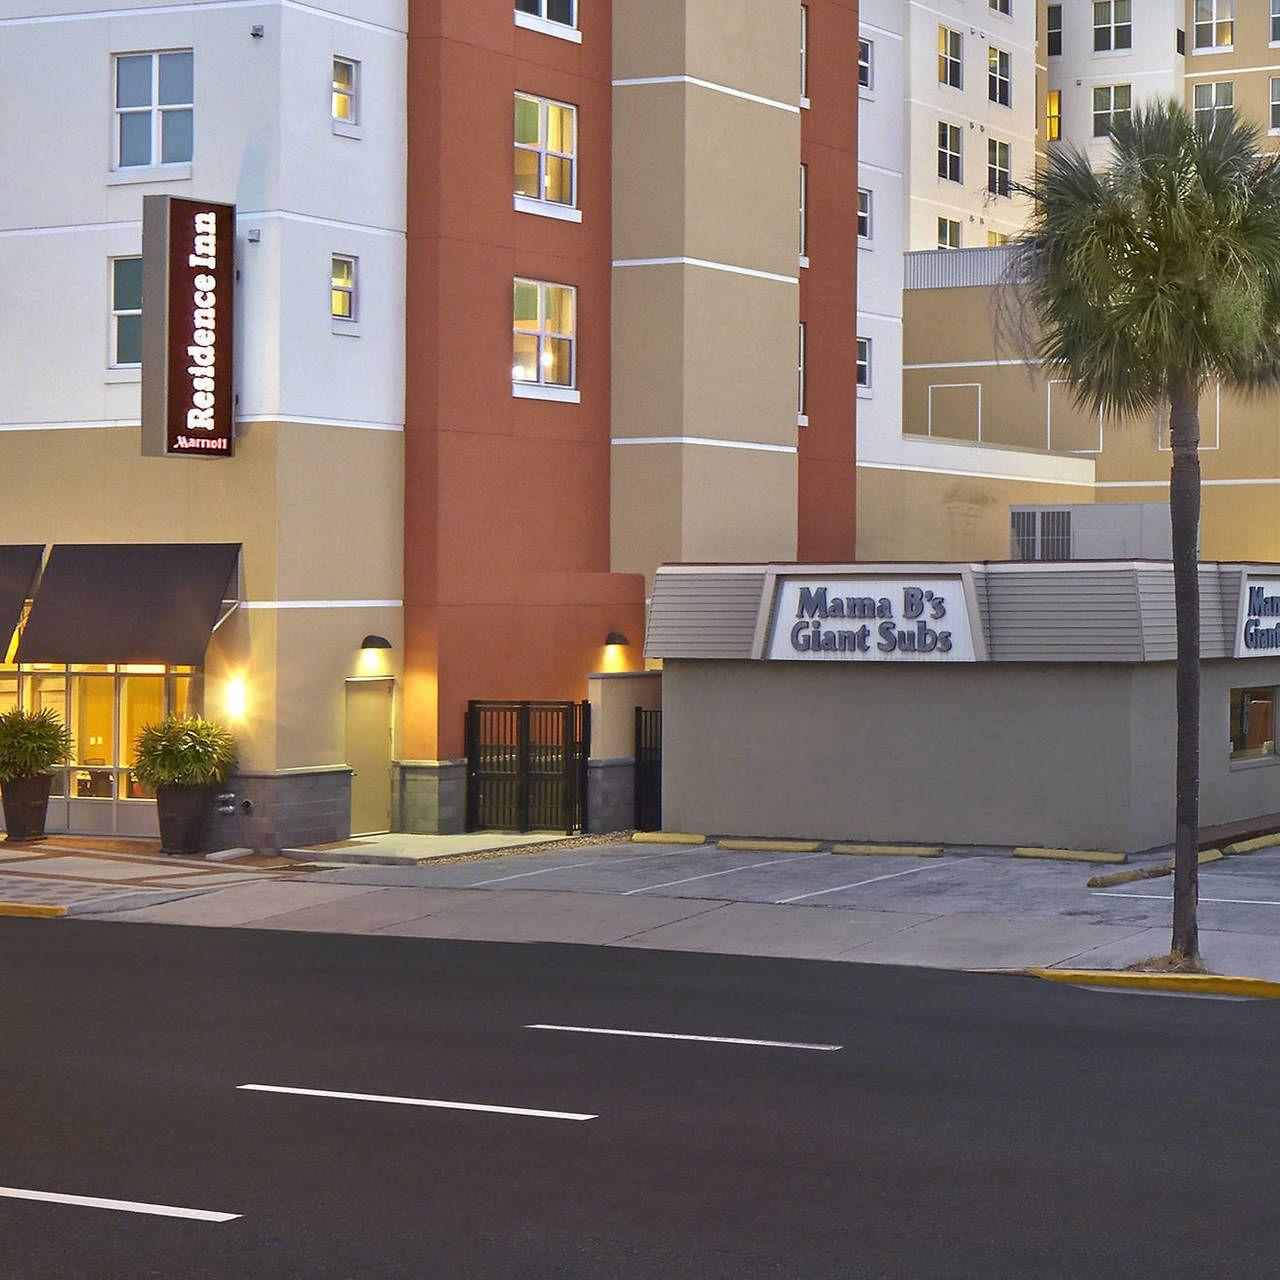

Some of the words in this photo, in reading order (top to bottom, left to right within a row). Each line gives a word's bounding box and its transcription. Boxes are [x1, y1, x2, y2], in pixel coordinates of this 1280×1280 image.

[189, 212, 216, 269] Inn
[188, 274, 216, 430] Residence
[173, 436, 227, 450] Marriott
[795, 586, 893, 619] Mama
[902, 587, 947, 619] B's
[790, 621, 870, 652] Giant
[877, 620, 952, 652] Subs
